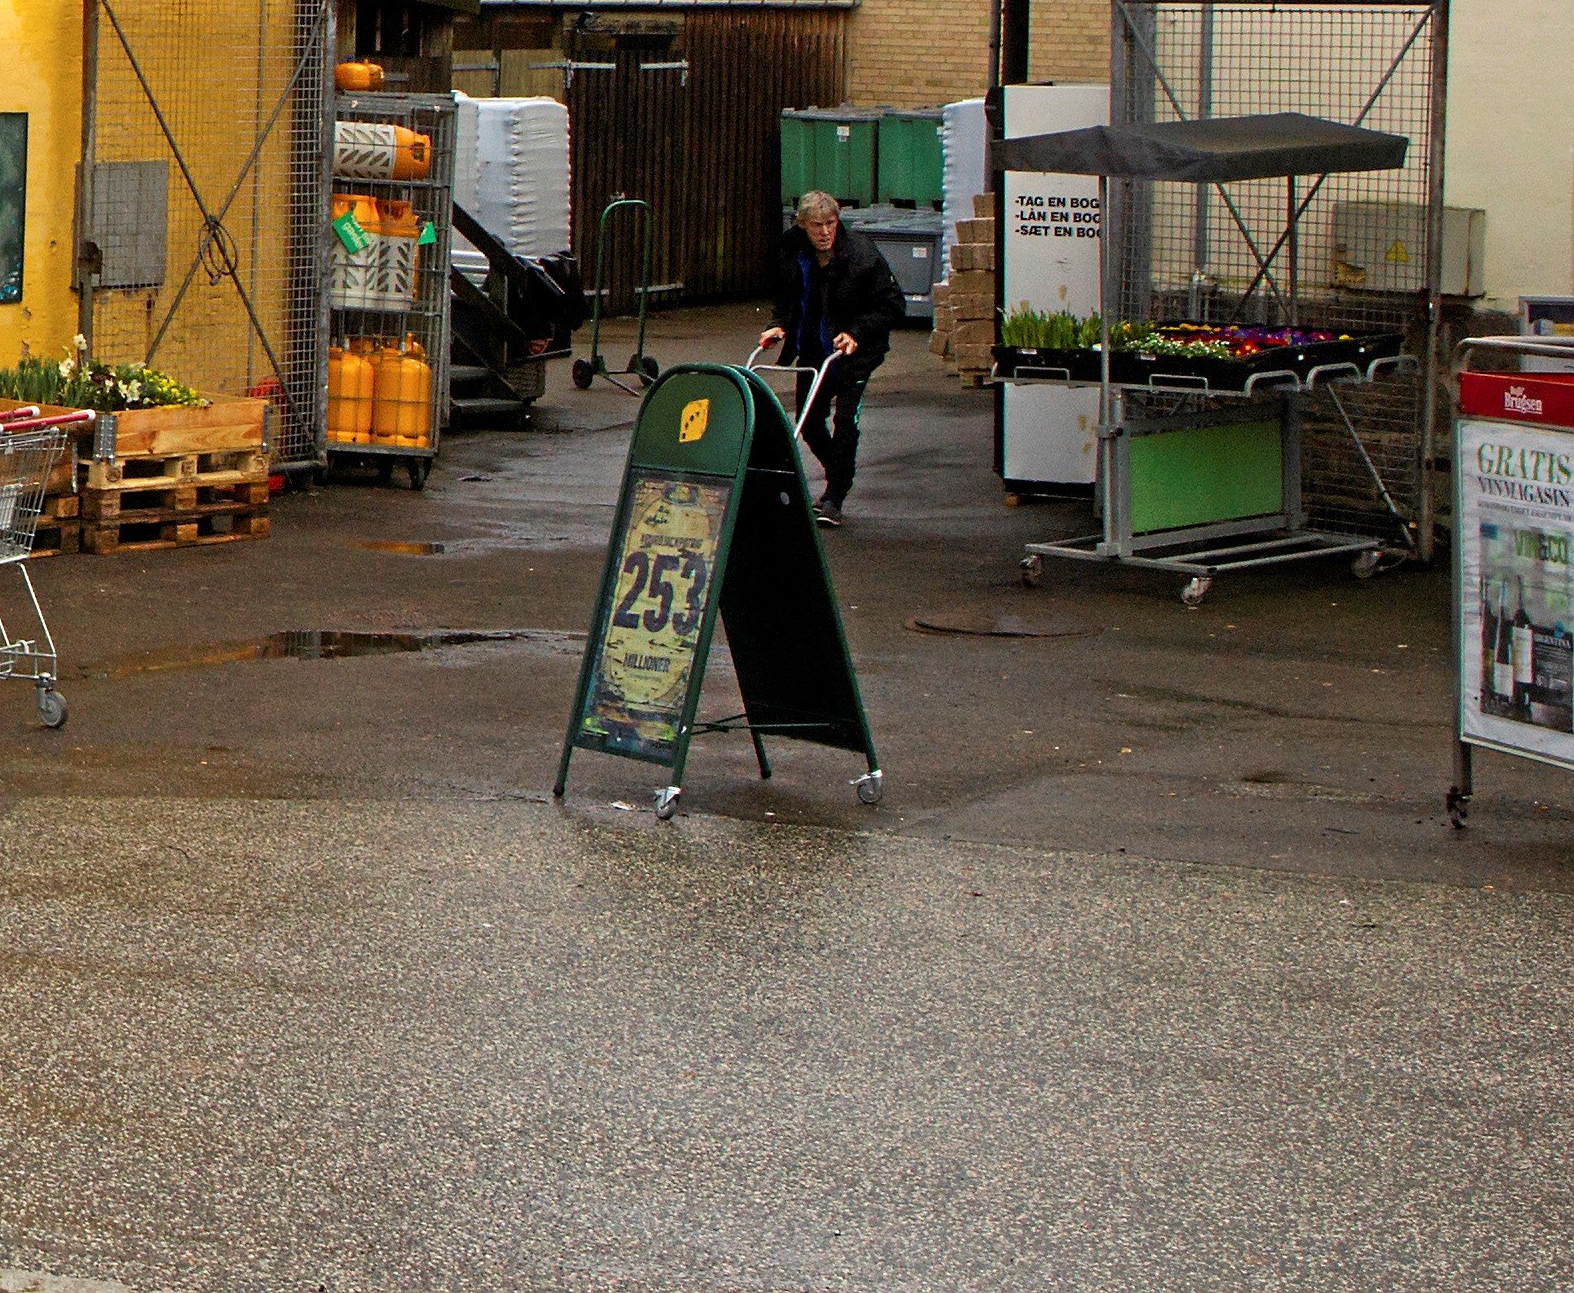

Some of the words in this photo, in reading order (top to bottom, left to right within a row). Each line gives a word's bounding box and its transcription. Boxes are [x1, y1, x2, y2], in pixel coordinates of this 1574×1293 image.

[1048, 197, 1066, 208] EN
[1051, 211, 1069, 222] EN
[1054, 226, 1072, 237] EN
[1477, 443, 1572, 486] GRATIS
[612, 551, 709, 636] 253
